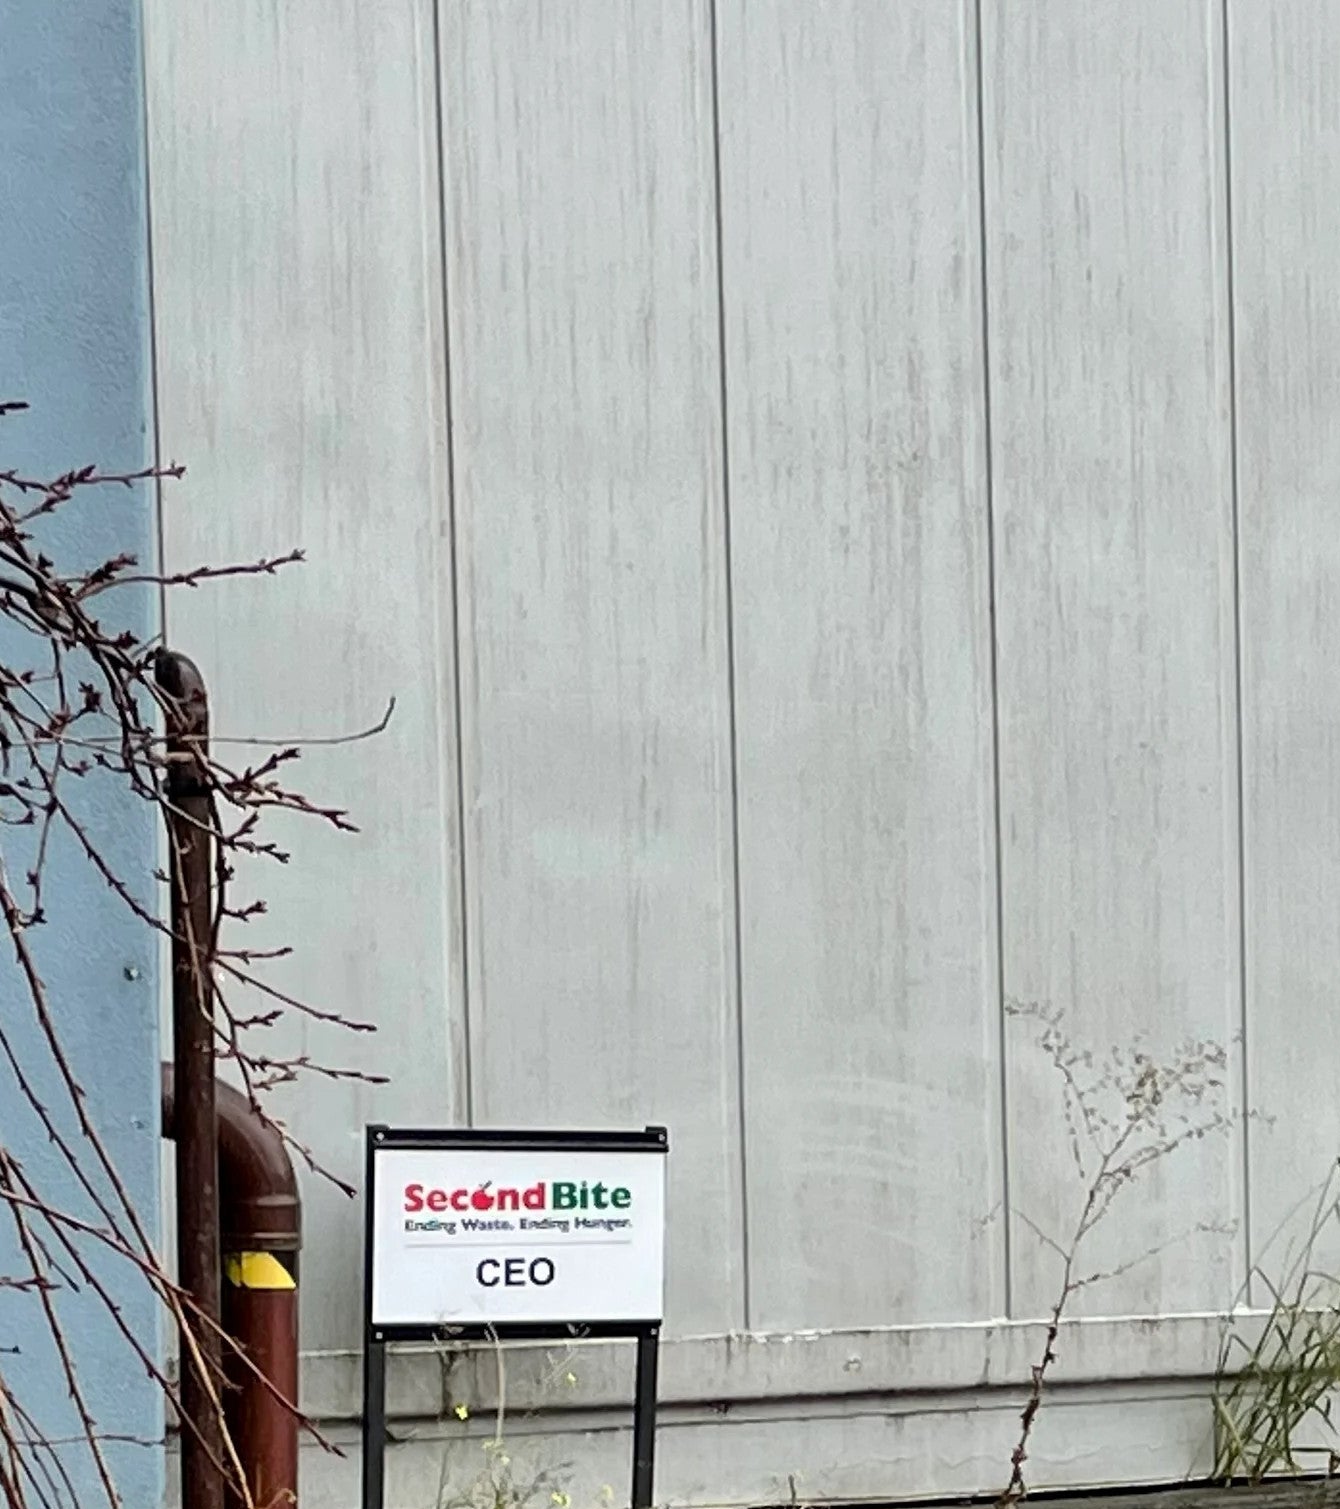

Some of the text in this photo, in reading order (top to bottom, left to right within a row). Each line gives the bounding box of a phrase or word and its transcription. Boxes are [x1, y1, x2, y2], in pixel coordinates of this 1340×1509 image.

[404, 1181, 632, 1212] SecondBite
[404, 1219, 457, 1234] Ending
[519, 1218, 570, 1232] Ending
[475, 1257, 556, 1288] CEO
